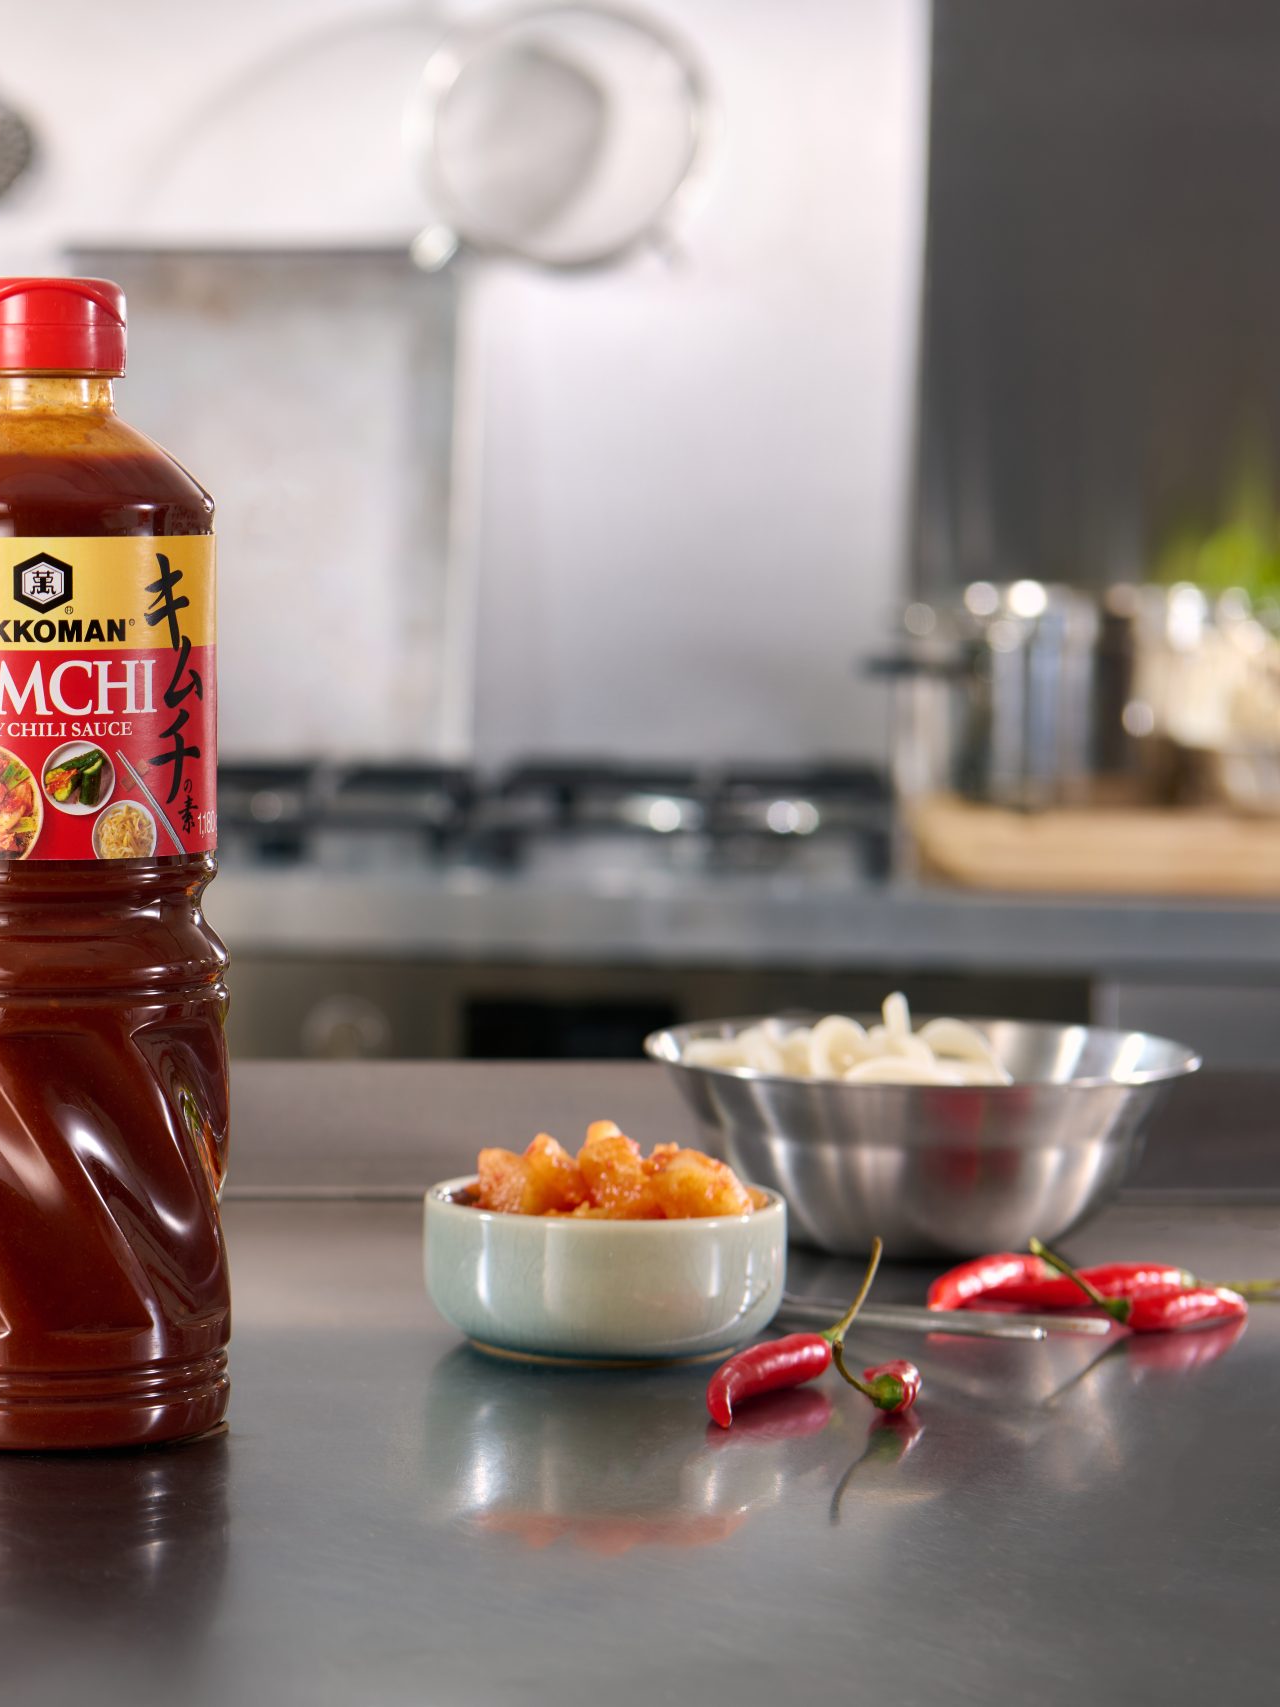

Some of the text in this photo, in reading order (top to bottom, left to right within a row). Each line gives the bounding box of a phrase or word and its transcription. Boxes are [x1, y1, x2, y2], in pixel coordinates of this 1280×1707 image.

[7, 722, 67, 737] CHILI
[71, 721, 133, 737] SAUCE
[144, 552, 203, 834] キムチの素
